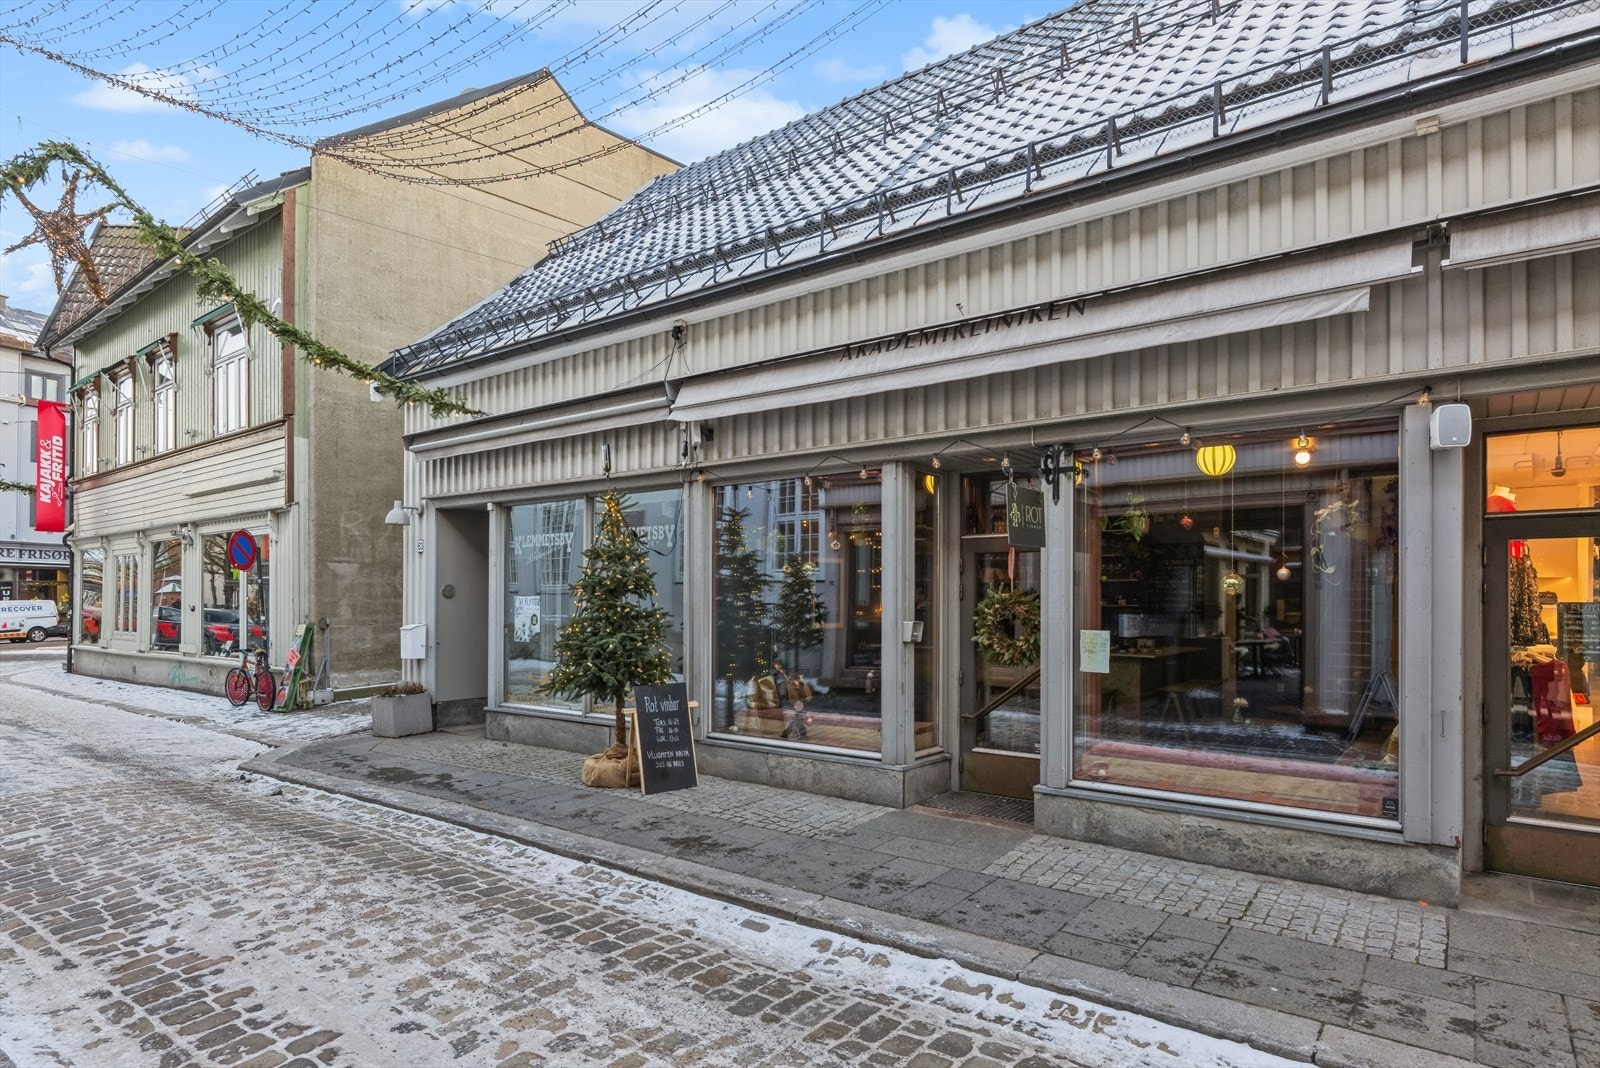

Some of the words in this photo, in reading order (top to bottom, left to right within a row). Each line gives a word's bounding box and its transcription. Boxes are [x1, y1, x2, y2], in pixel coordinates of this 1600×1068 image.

[40, 439, 52, 449] &
[51, 435, 64, 481] FRITID
[40, 450, 55, 503] KAJAKK
[1026, 505, 1044, 524] ROT
[514, 532, 574, 555] KLEMMETSBY
[18, 549, 70, 560] FRISØR
[1, 605, 43, 613] RECOVER
